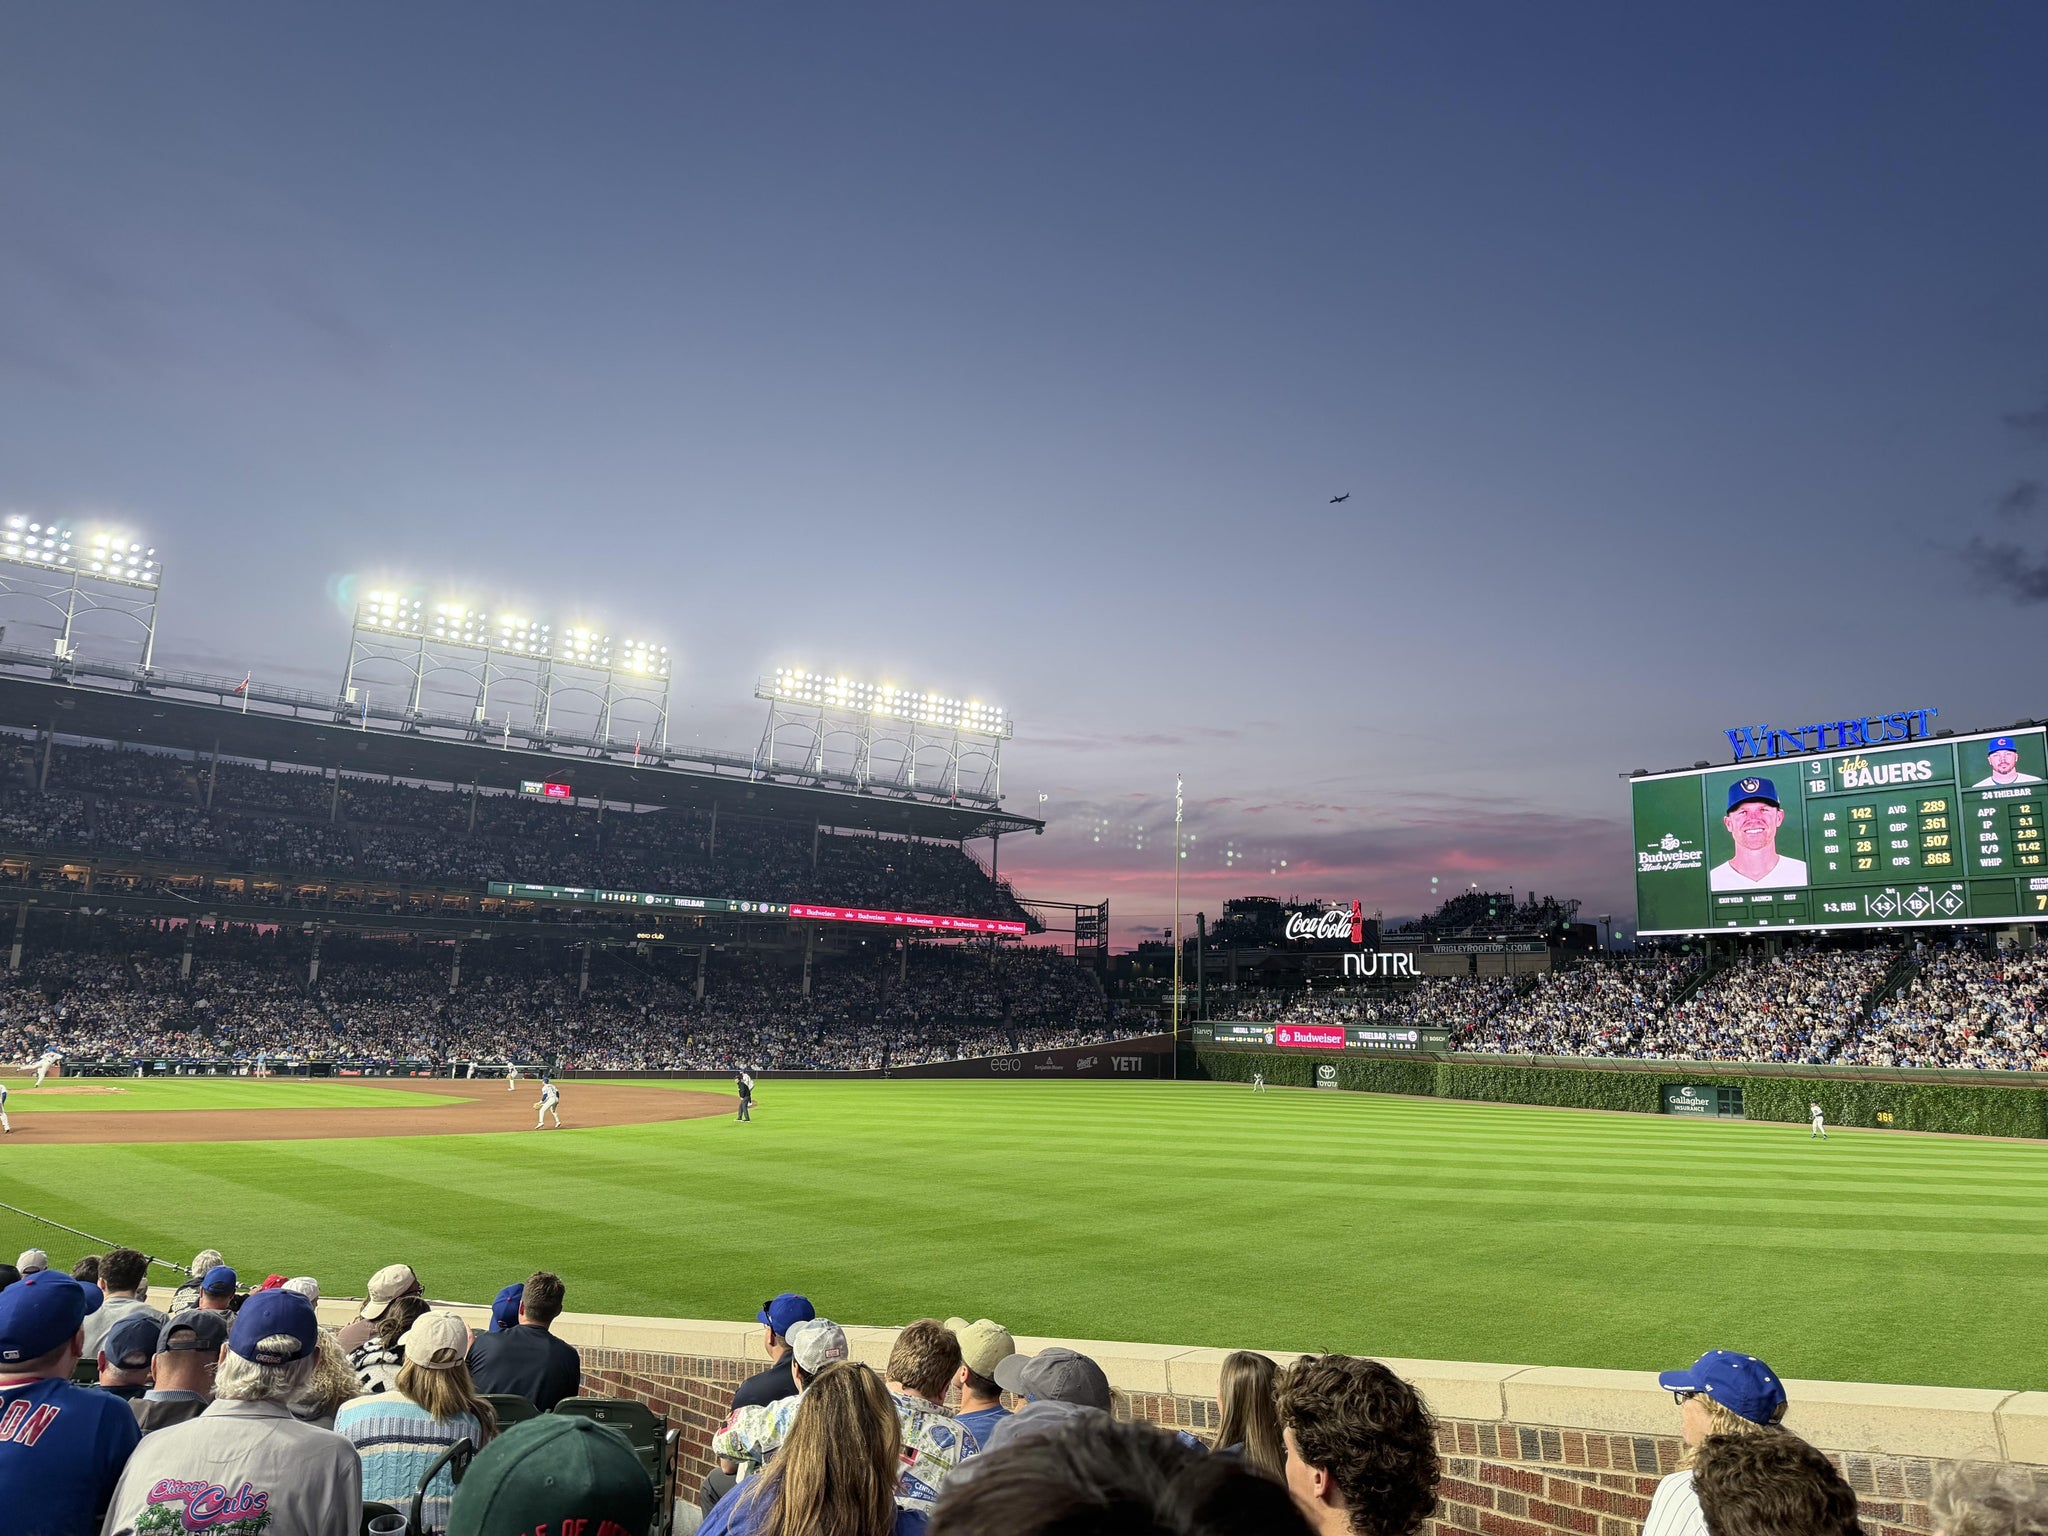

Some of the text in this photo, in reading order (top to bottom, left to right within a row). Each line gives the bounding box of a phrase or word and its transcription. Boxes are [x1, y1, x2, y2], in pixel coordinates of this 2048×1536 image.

[1723, 707, 1938, 760] WINTRUST
[1811, 761, 1821, 774] 9
[1838, 755, 1868, 774] Jake
[1843, 760, 1933, 788] BAUERS
[1809, 780, 1826, 792] 1B
[1982, 788, 2031, 799] 24 THIELBAR
[1888, 800, 1946, 815] AVG .289
[1978, 805, 2030, 817] APP 12
[1823, 807, 1873, 822] AB 142
[1889, 817, 1947, 832] OBP .361
[1983, 817, 2033, 829] IP 9.1
[1824, 824, 1867, 838] HR 7
[1980, 830, 2038, 841] ERA 2.89
[1824, 841, 1872, 854] RBI 28
[1891, 835, 1949, 849] SLG .507
[1981, 842, 2041, 854] K/9 11.42
[1638, 849, 1703, 864] Budweiser
[1892, 852, 1951, 866] OPS .868
[1980, 855, 2039, 867] WHIP 1.18
[1829, 858, 1873, 870] R 27
[619, 894, 626, 902] 0
[1945, 898, 1955, 908] K
[2036, 895, 2048, 911] 7
[1876, 902, 1890, 911] 1-3
[1909, 900, 1923, 910] 1B
[1285, 910, 1354, 940] Coca-Cola
[1193, 1027, 1213, 1037] Harvey
[1294, 1031, 1342, 1044] Budweiser
[990, 1057, 1021, 1072] eero
[1111, 1057, 1142, 1072] YETI
[1669, 1095, 1709, 1107] Gallagher
[1877, 1112, 1894, 1122] 368
[0, 1396, 60, 1447] ON
[151, 1479, 208, 1497] Chicago
[189, 1482, 268, 1520] Cubs
